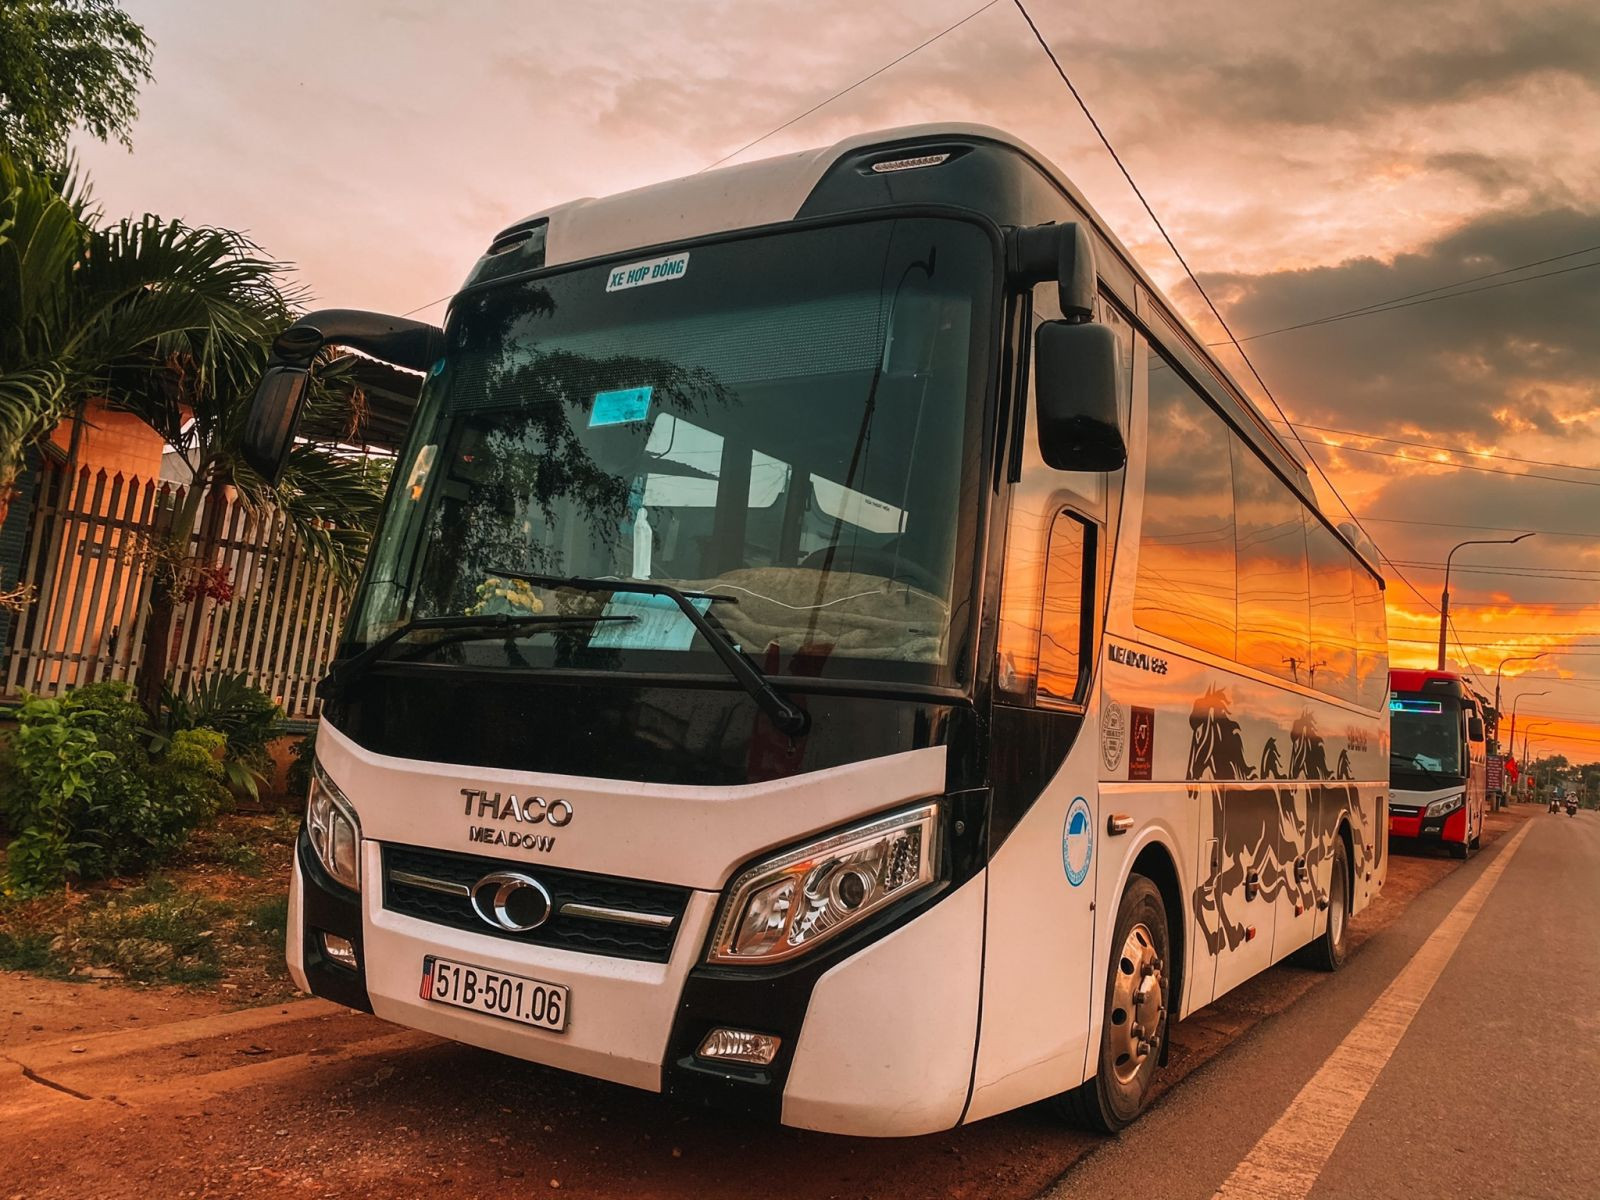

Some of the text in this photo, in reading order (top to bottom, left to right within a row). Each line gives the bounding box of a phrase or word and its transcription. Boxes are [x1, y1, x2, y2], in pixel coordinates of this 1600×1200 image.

[609, 271, 625, 288] XE
[626, 266, 650, 285] HỢP
[460, 788, 574, 828] THACO
[468, 825, 556, 853] MEADOW
[436, 963, 562, 1025] 51B-501.06
